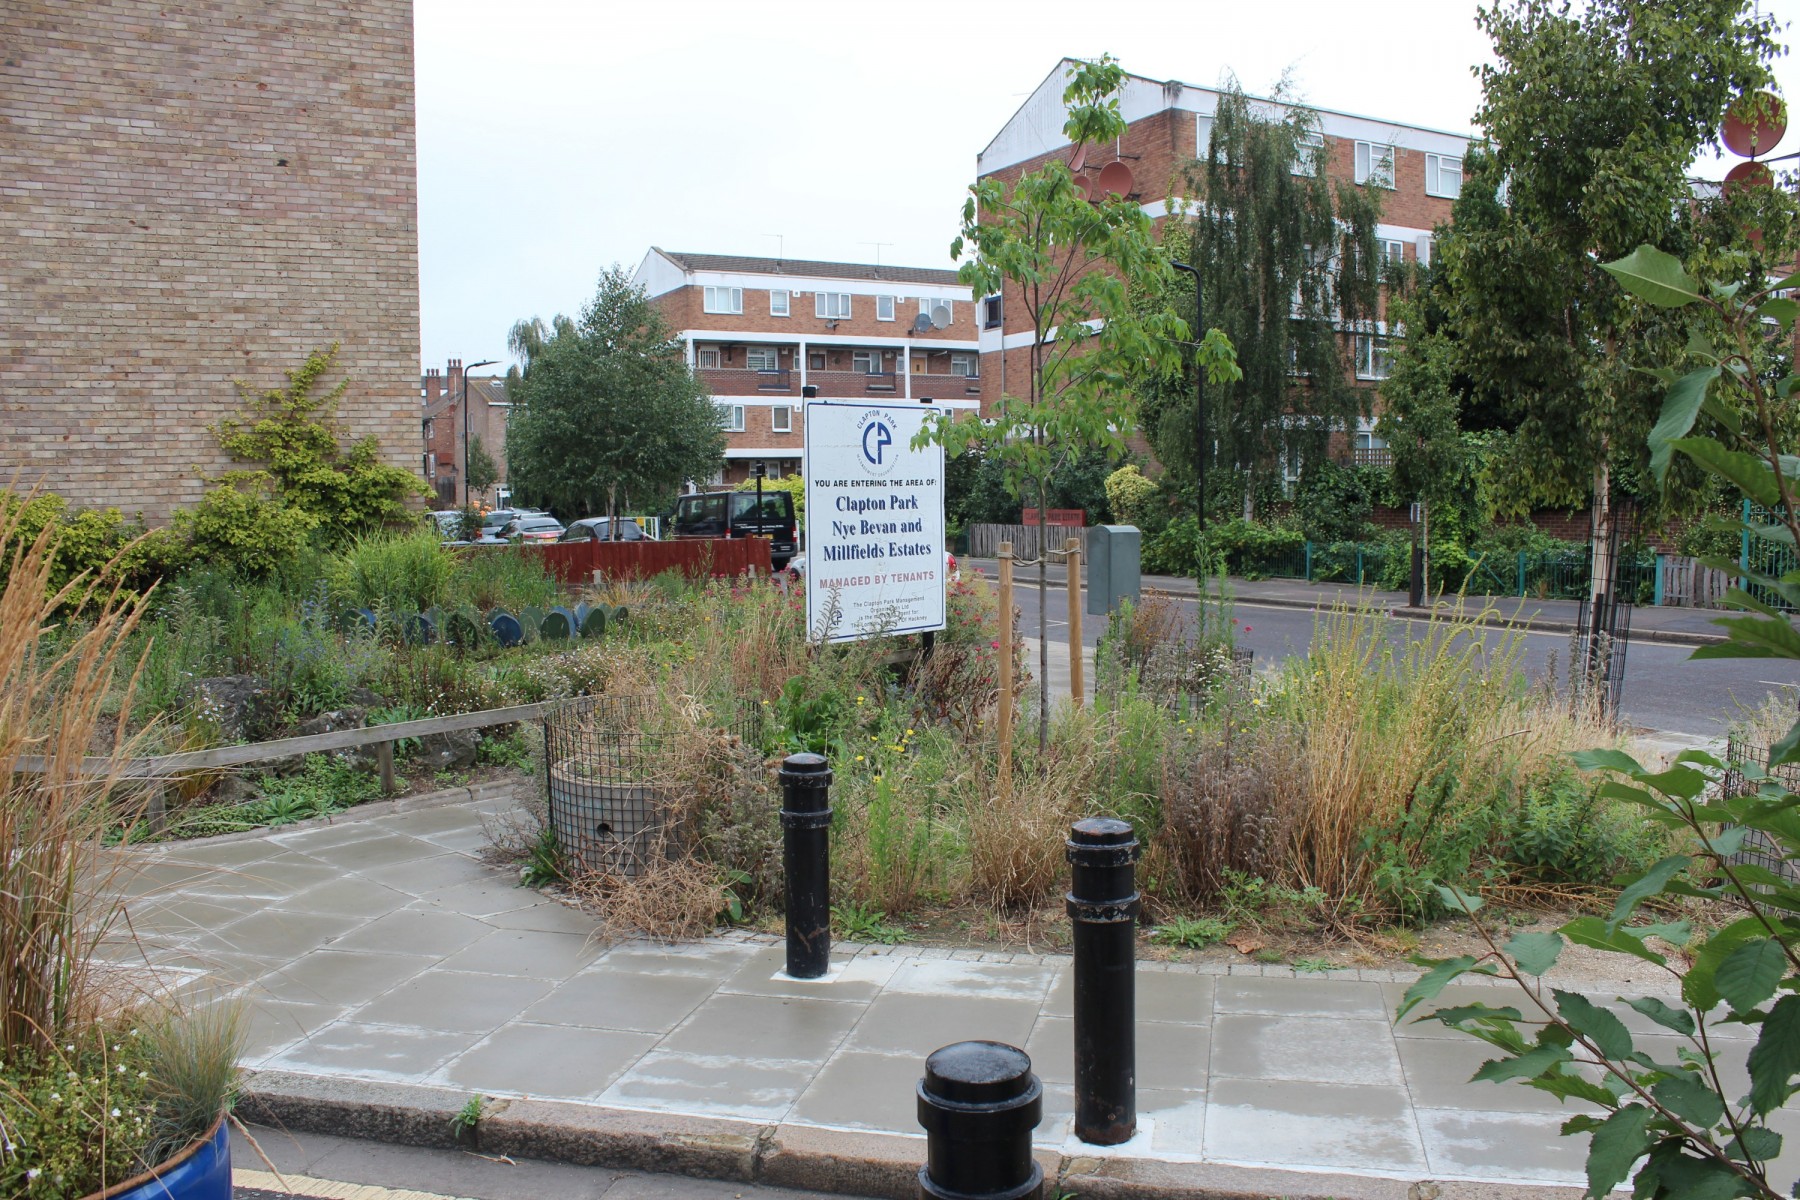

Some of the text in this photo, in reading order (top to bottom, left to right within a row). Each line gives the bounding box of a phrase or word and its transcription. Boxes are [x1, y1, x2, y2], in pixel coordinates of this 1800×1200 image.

[856, 409, 898, 430] CLAPTON PARK
[815, 480, 831, 488] YOU
[833, 480, 848, 488] ARE
[851, 480, 887, 488] ENTERING
[905, 479, 924, 487] AREA
[926, 479, 937, 487] OF:
[836, 494, 919, 515] Clapton Park
[832, 517, 923, 540] Nye Bevan and
[823, 541, 932, 562] Millfields Estates
[820, 570, 935, 589] MANAGED BY TENANTS
[895, 595, 925, 604] Management
